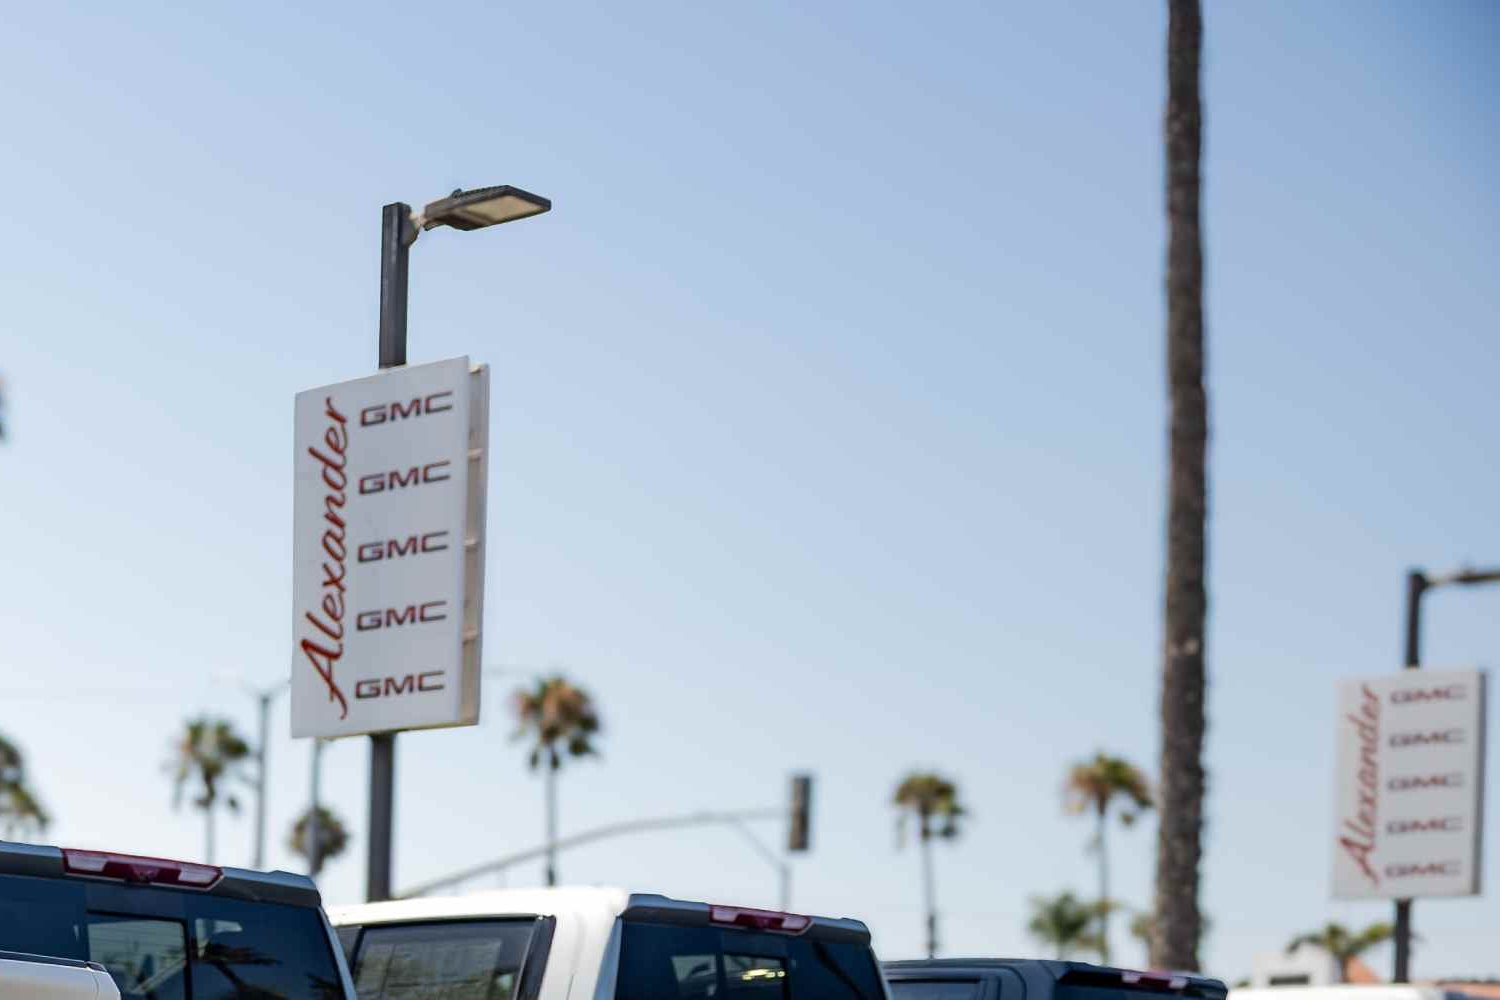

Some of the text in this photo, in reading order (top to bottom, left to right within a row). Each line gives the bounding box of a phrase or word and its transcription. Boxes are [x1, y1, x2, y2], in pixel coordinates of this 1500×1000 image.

[360, 391, 453, 427] GMC
[358, 461, 452, 495] GMC
[300, 397, 348, 720] Alexander
[357, 531, 449, 563] GMC
[356, 601, 448, 631] GMC
[355, 670, 446, 699] GMC
